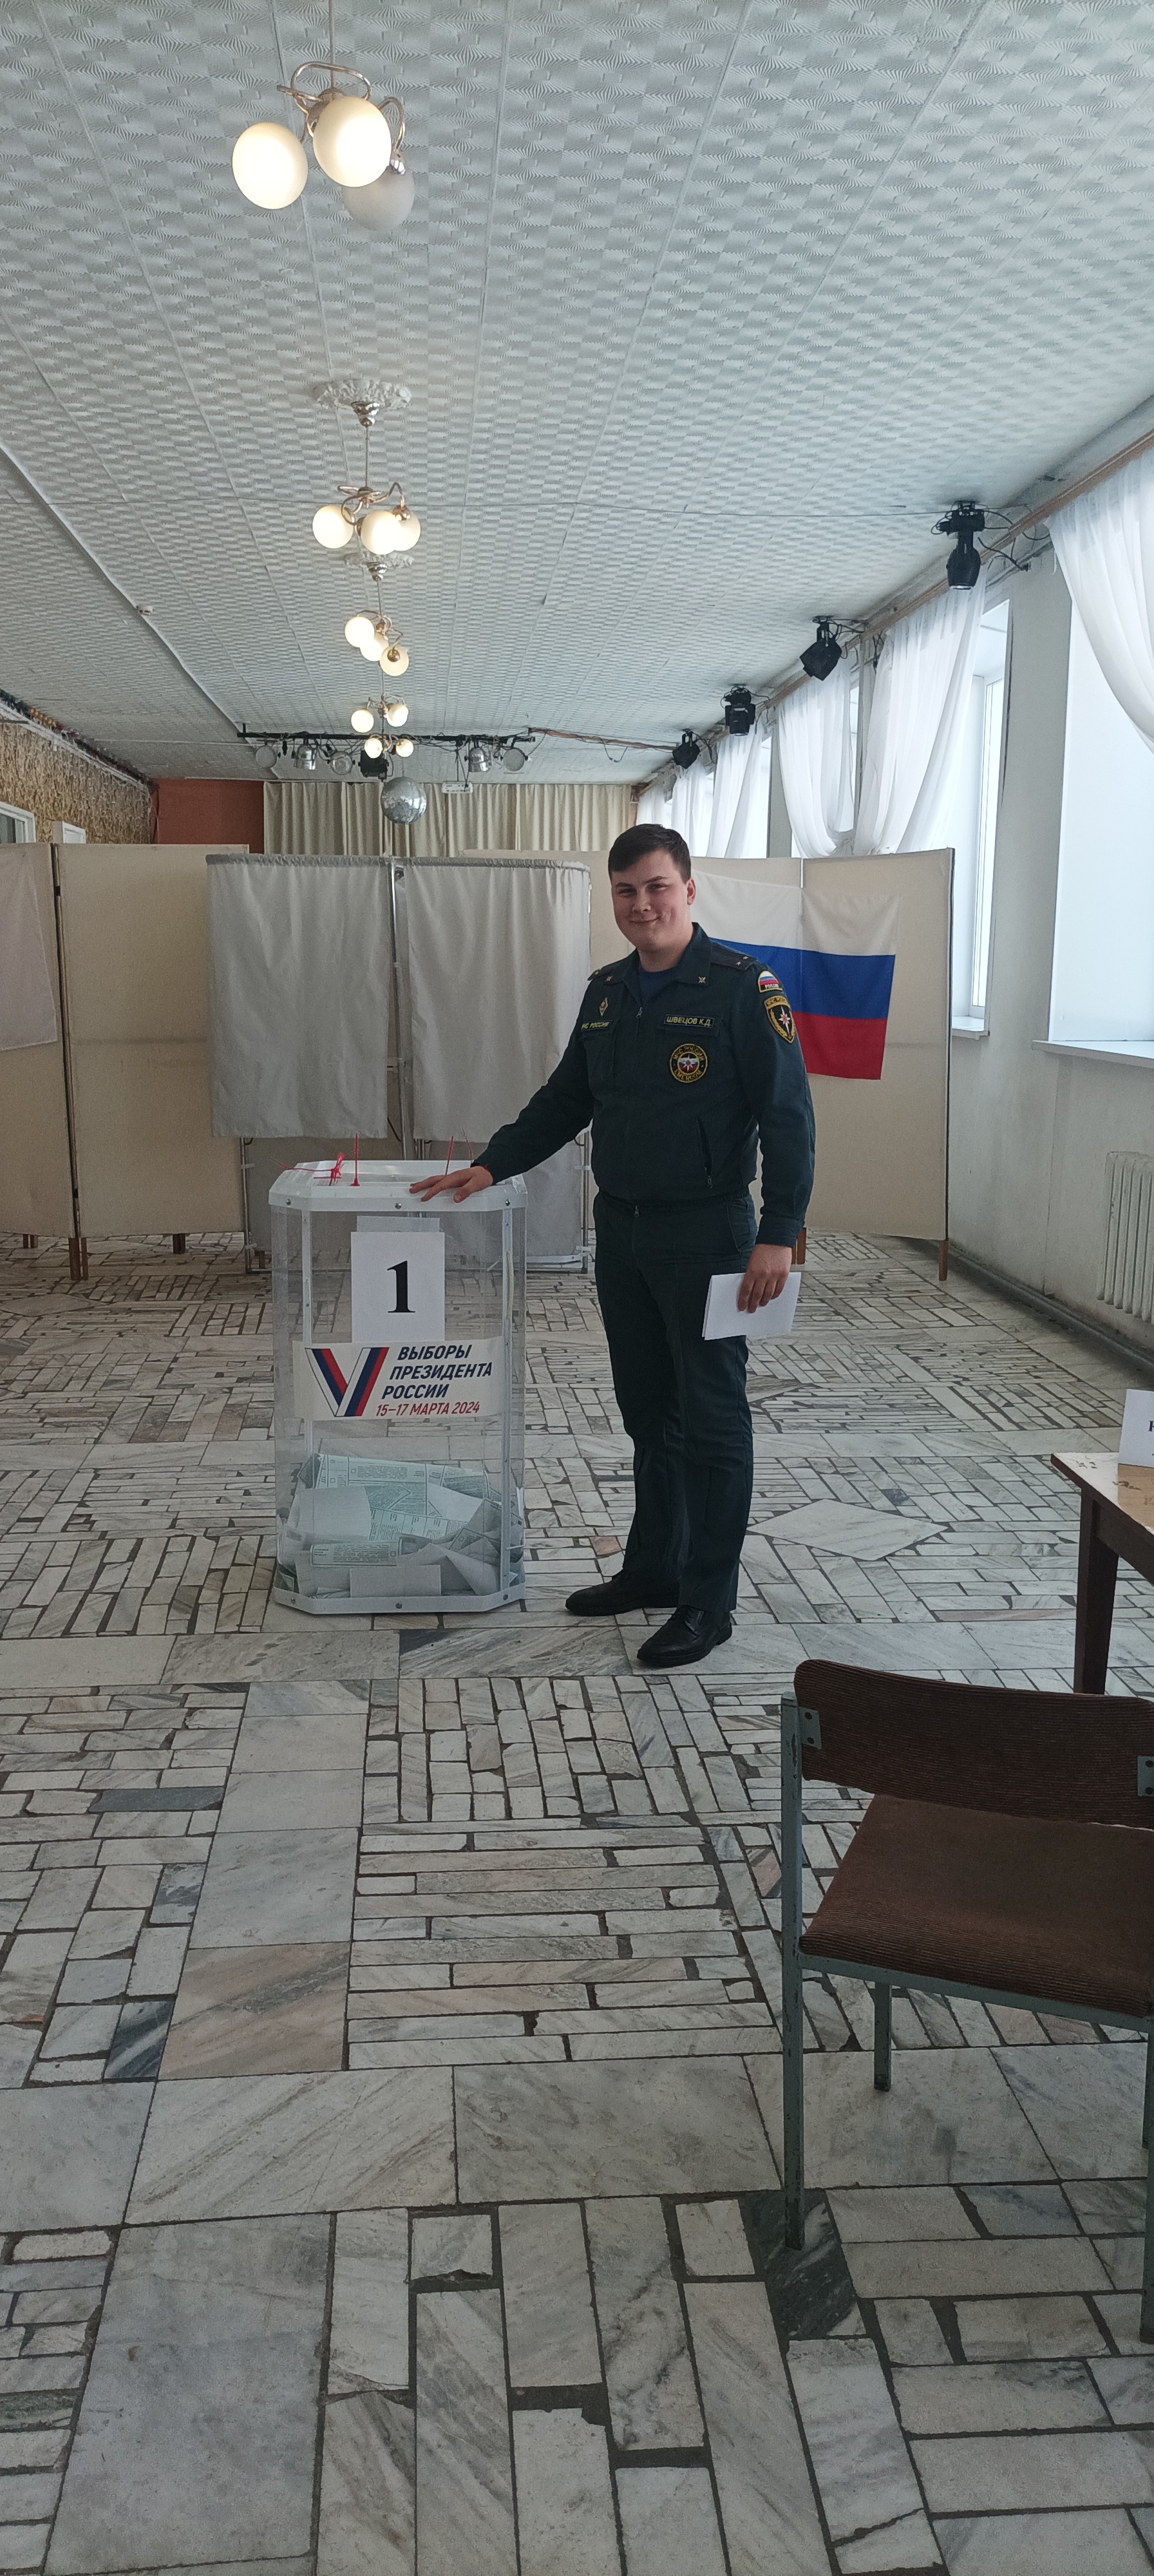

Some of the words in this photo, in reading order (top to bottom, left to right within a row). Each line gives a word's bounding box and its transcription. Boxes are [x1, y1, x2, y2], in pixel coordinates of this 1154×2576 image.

[667, 1016, 698, 1025] ШВЕЦОВ
[386, 1260, 416, 1313] 1
[397, 1344, 472, 1360] ВЫБОРЫ
[389, 1362, 493, 1381] ПРЕЗИДЕНТА
[381, 1384, 449, 1399] РОССИИ
[410, 1403, 449, 1416] МАРТА
[451, 1401, 480, 1414] 2024
